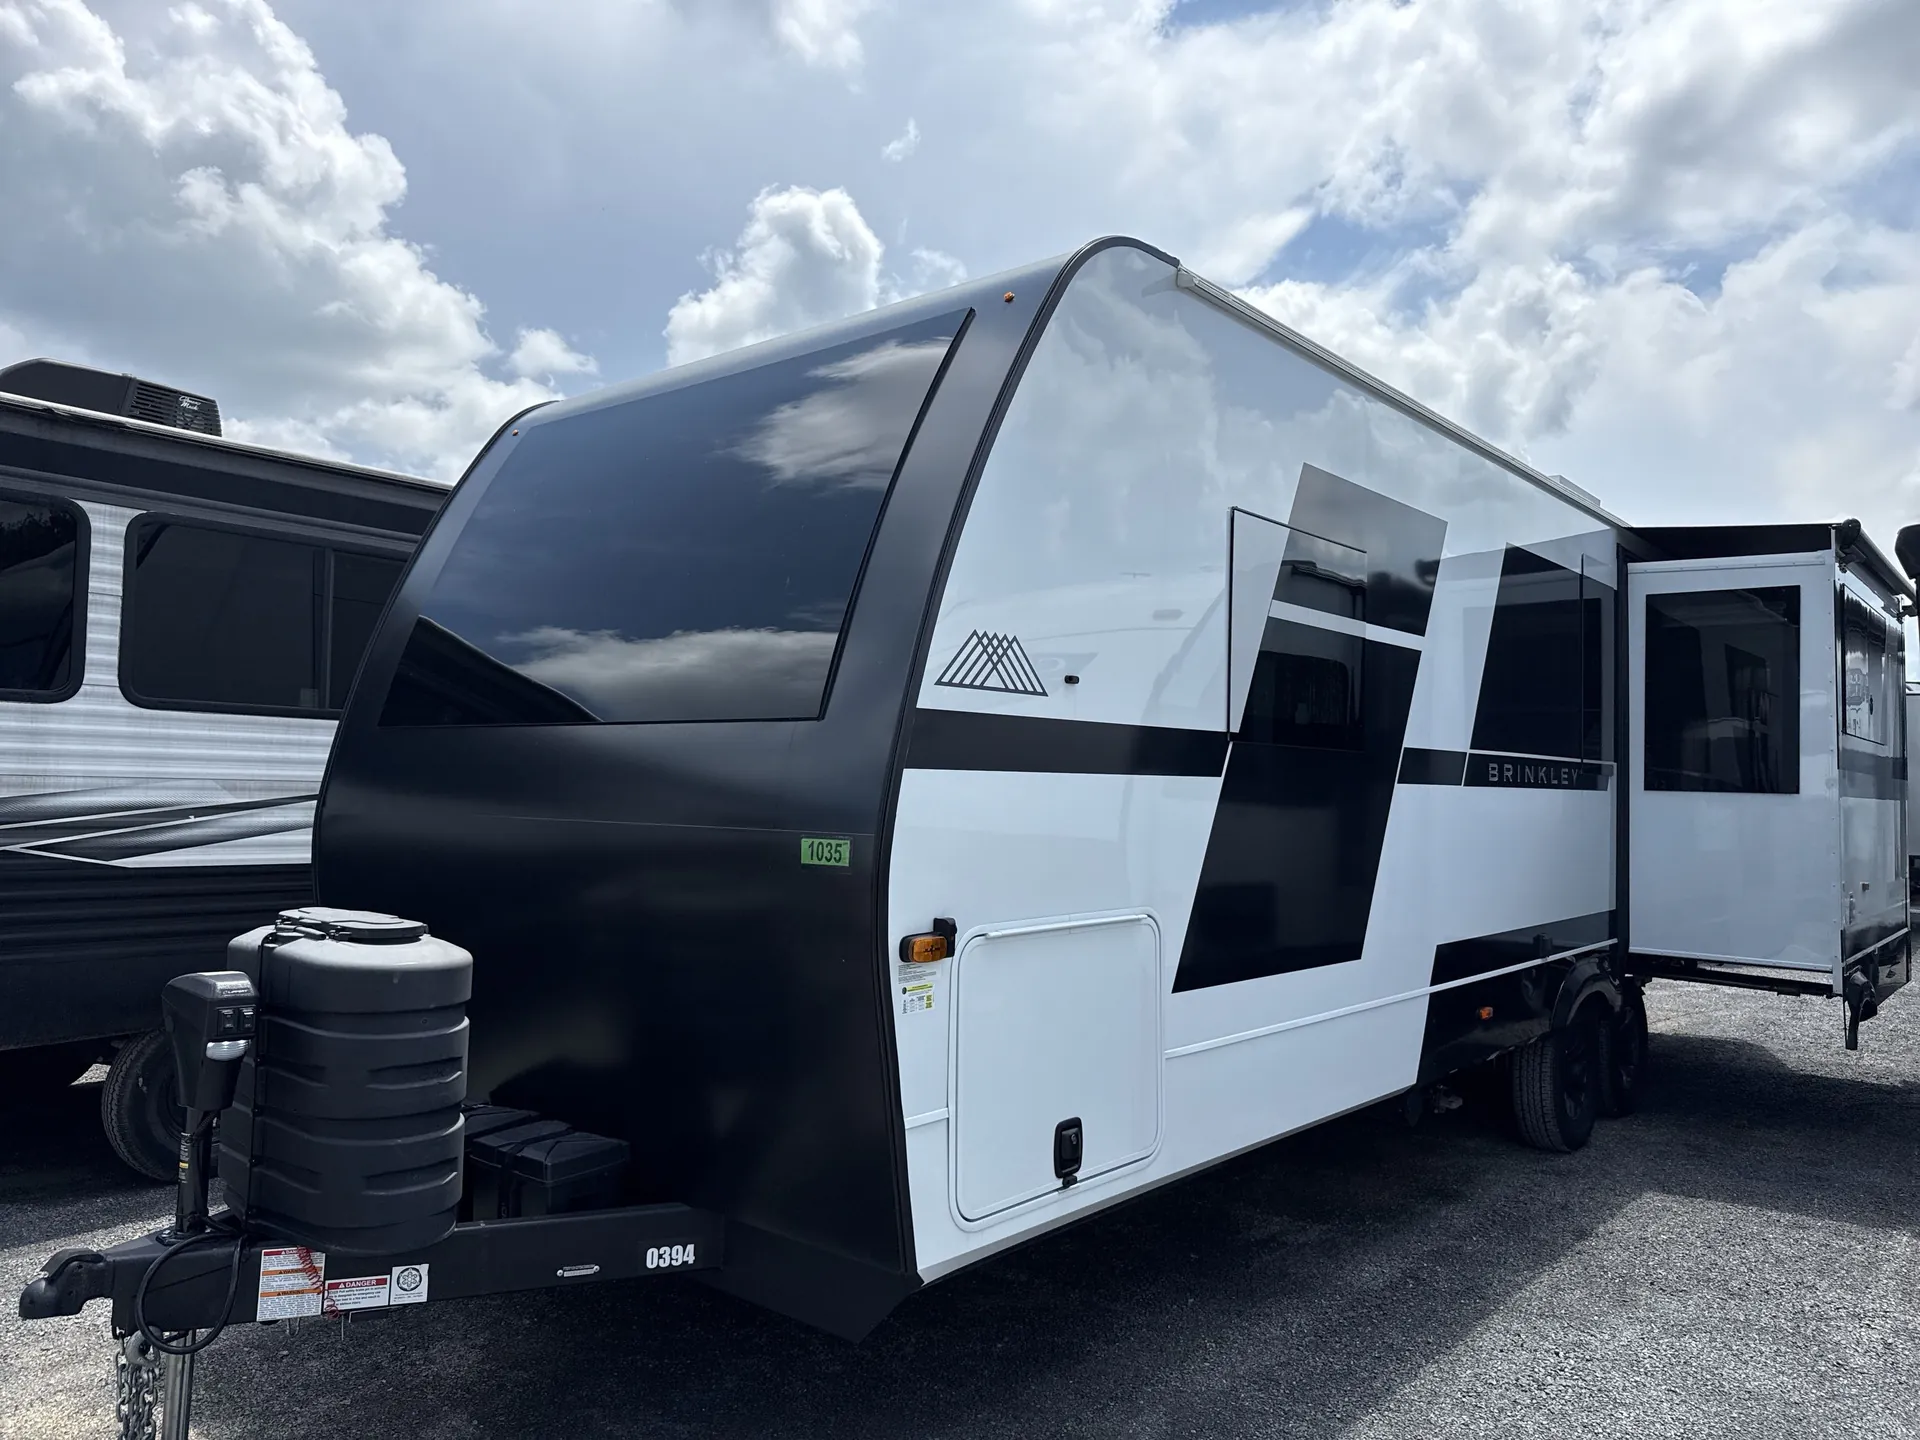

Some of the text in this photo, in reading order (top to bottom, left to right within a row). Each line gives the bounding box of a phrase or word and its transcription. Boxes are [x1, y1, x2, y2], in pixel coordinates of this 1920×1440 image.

[1488, 763, 1578, 785] BRINKLEY
[808, 840, 843, 863] 1035
[646, 1244, 695, 1269] 0394
[345, 1280, 377, 1288] DANGER
